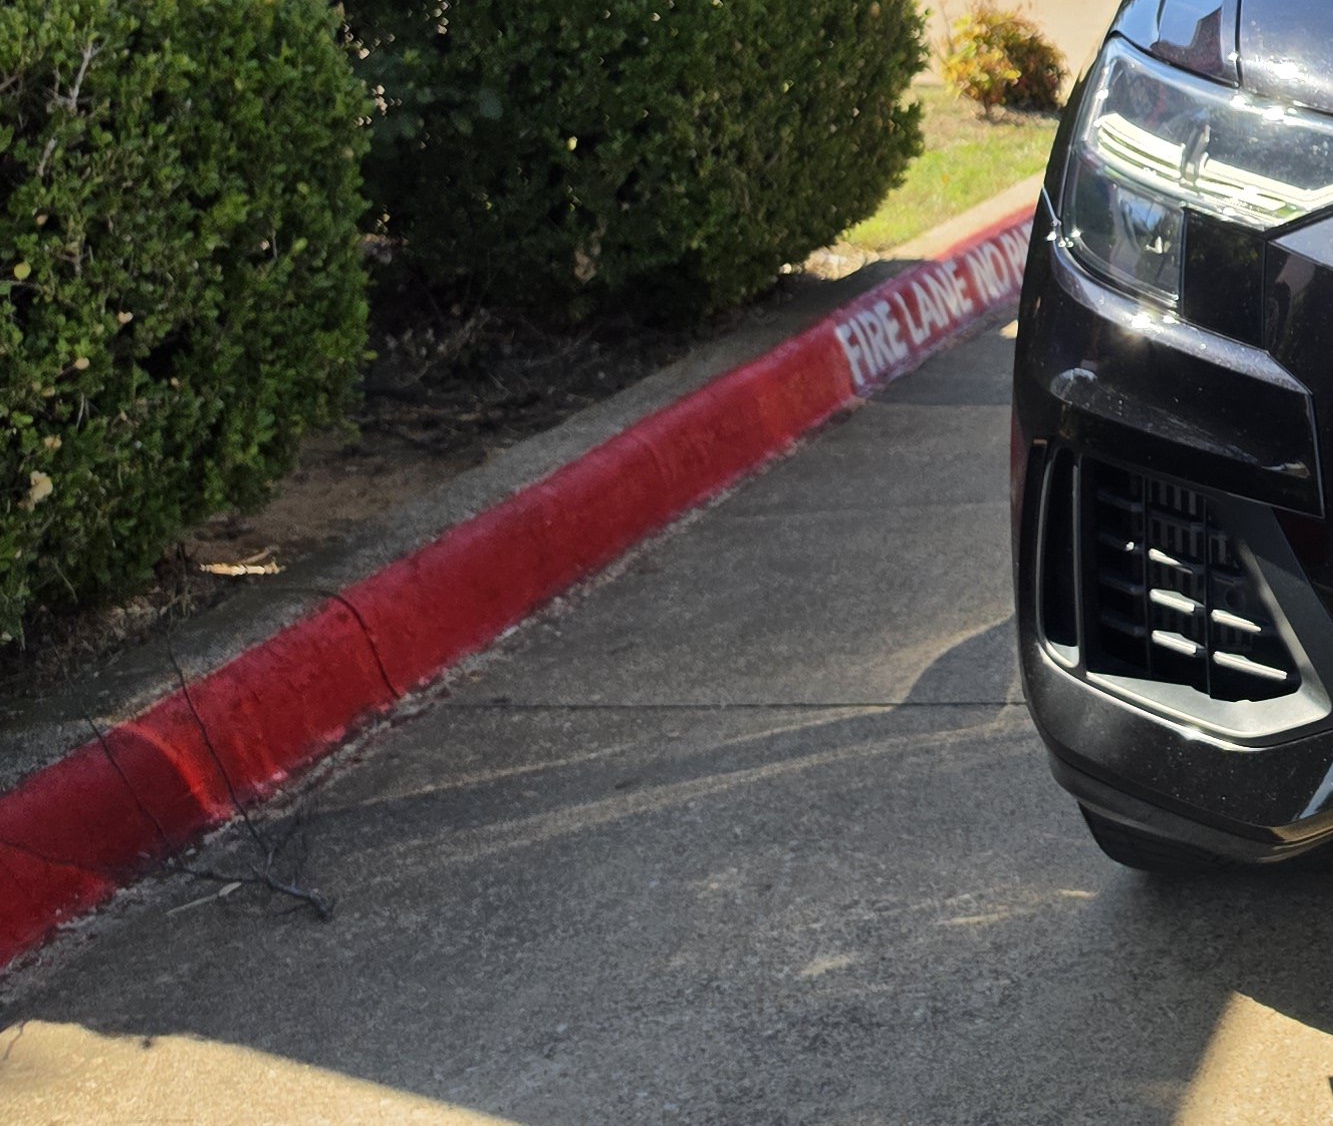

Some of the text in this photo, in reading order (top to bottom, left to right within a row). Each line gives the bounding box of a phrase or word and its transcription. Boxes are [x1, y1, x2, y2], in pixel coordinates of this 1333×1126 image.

[834, 301, 909, 387] FIRE
[894, 261, 973, 346] LANE
[965, 242, 1012, 306] NO
